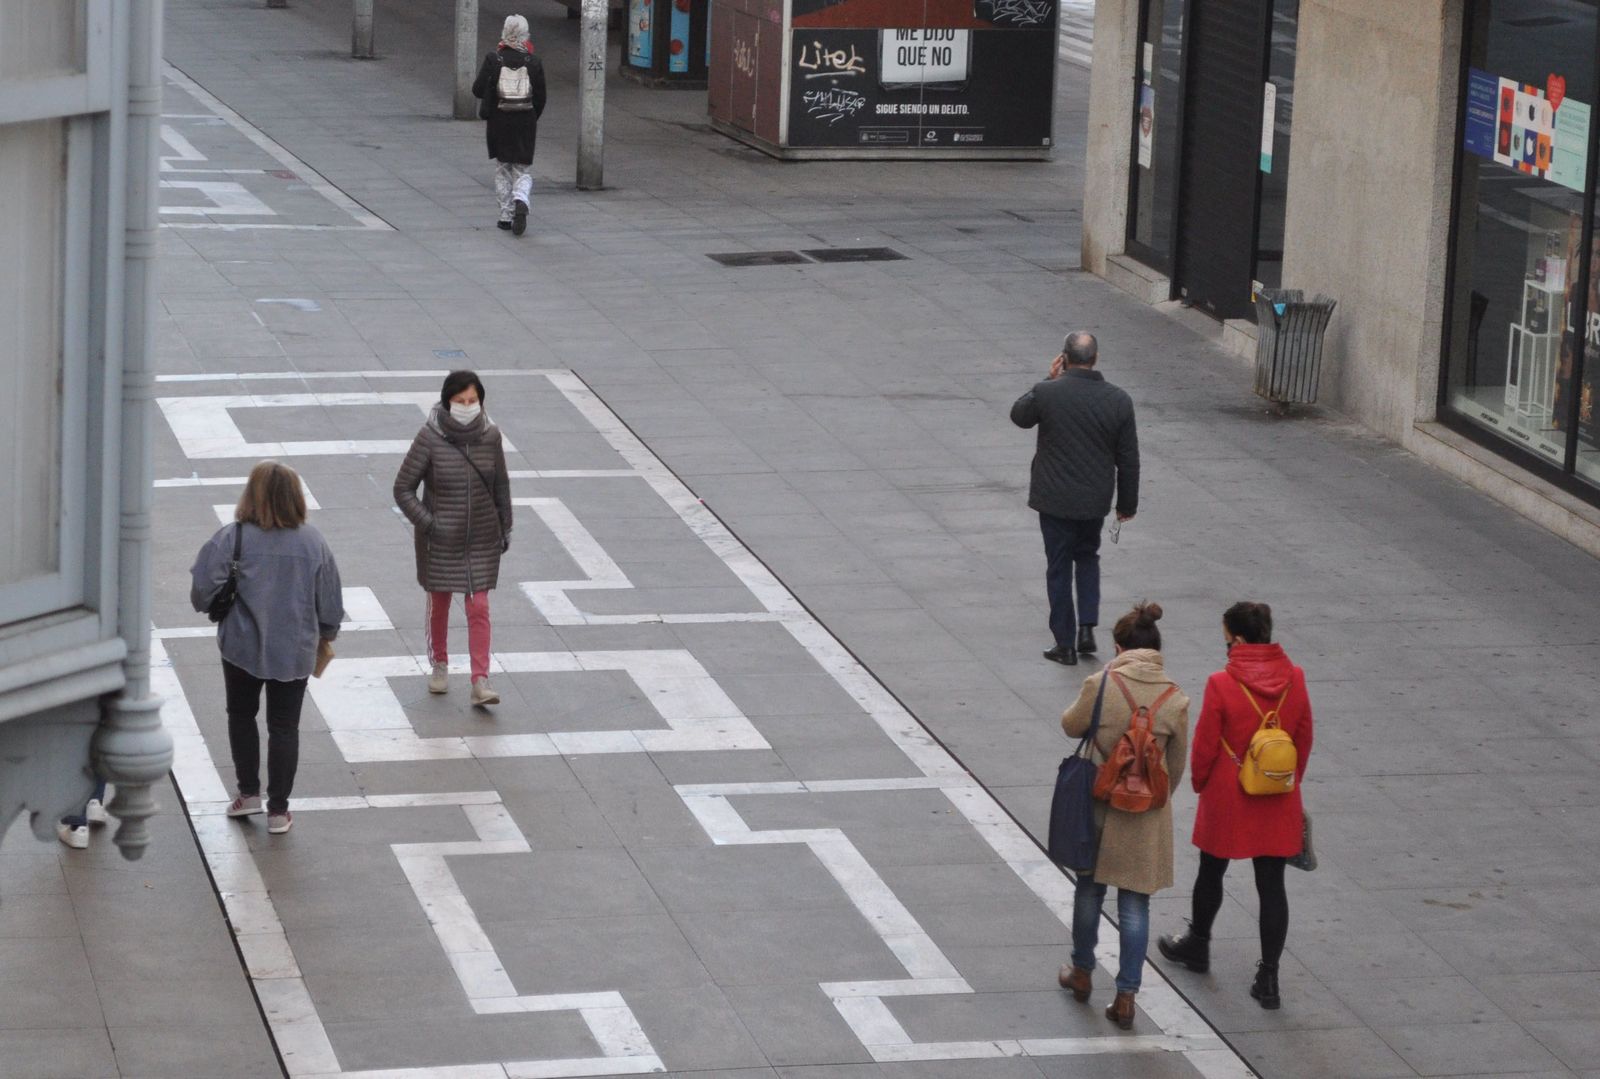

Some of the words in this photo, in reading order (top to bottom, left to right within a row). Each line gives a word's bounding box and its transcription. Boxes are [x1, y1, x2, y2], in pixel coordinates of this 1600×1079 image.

[896, 28, 918, 41] ME
[897, 46, 927, 67] QUE
[931, 46, 952, 66] NO
[875, 103, 898, 114] SIGUE
[899, 103, 928, 114] SIENDO
[929, 104, 940, 114] UN
[941, 104, 970, 115] DELITO.
